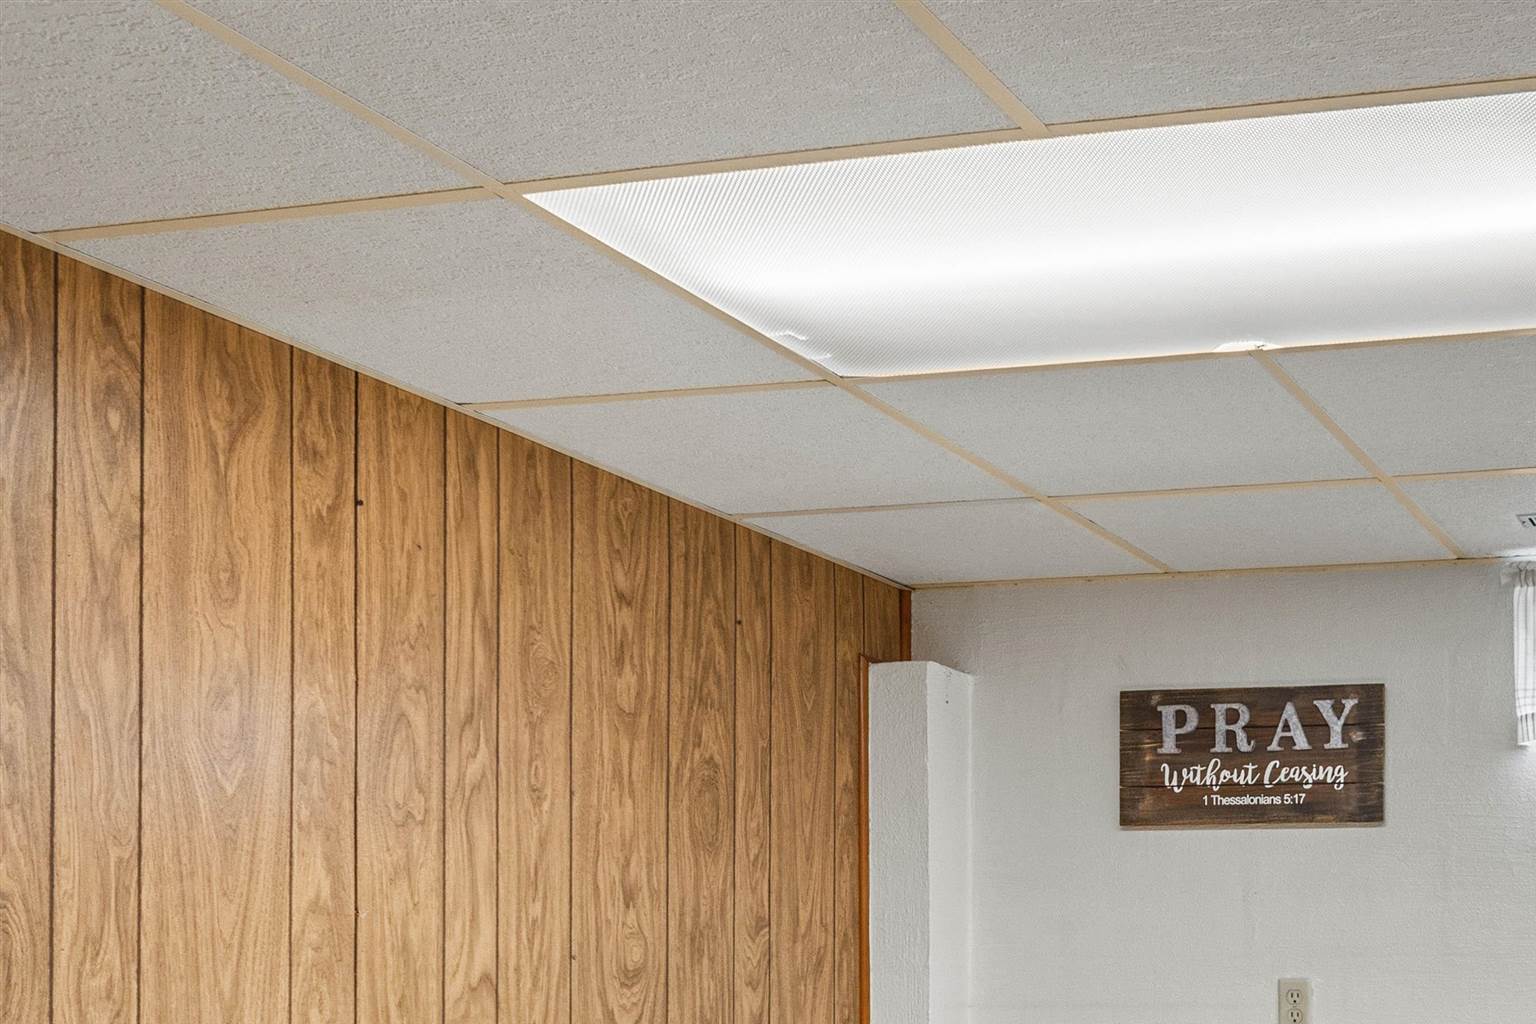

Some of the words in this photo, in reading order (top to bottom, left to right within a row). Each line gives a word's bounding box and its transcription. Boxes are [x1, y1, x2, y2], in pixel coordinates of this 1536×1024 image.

[1157, 698, 1359, 754] PRAY
[1161, 758, 1260, 793] Without
[1263, 760, 1348, 790] Ceasing
[1203, 795, 1208, 806] 1
[1210, 795, 1281, 806] Thessalonians
[1283, 794, 1306, 805] 5:17
